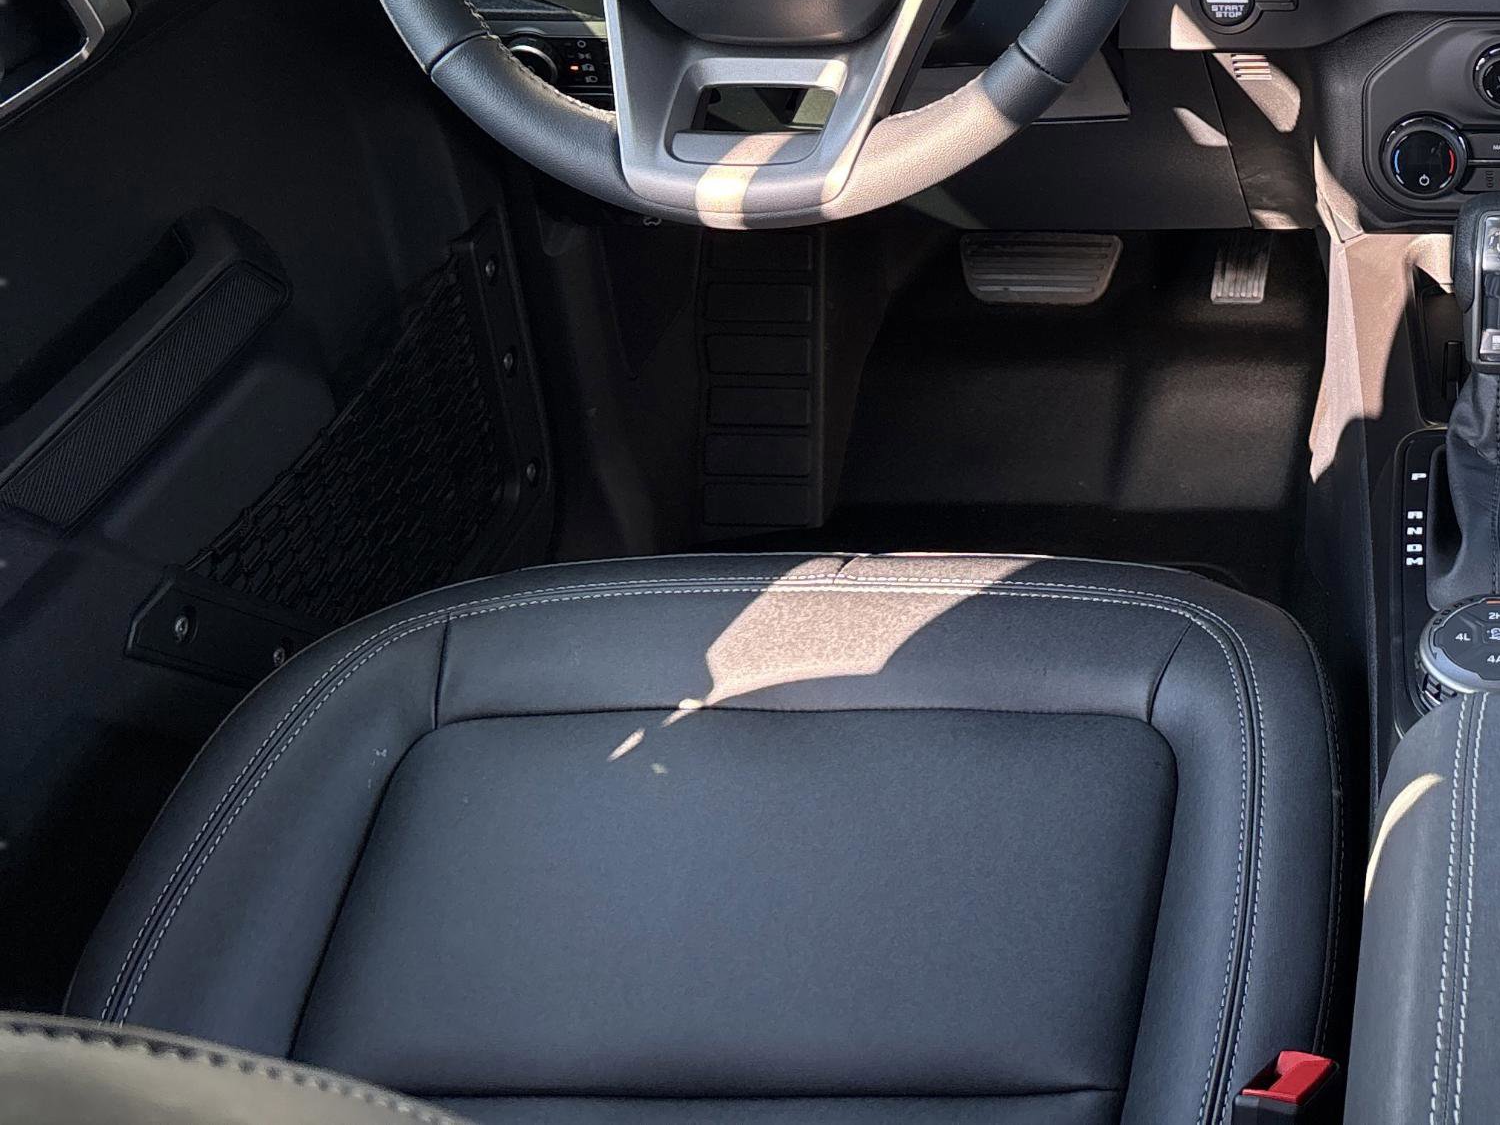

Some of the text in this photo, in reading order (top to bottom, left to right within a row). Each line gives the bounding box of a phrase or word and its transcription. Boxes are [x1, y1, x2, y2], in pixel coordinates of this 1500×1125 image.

[1407, 527, 1422, 535] N
[1406, 543, 1422, 552] D
[1406, 557, 1424, 565] M
[1455, 633, 1471, 641] 4L
